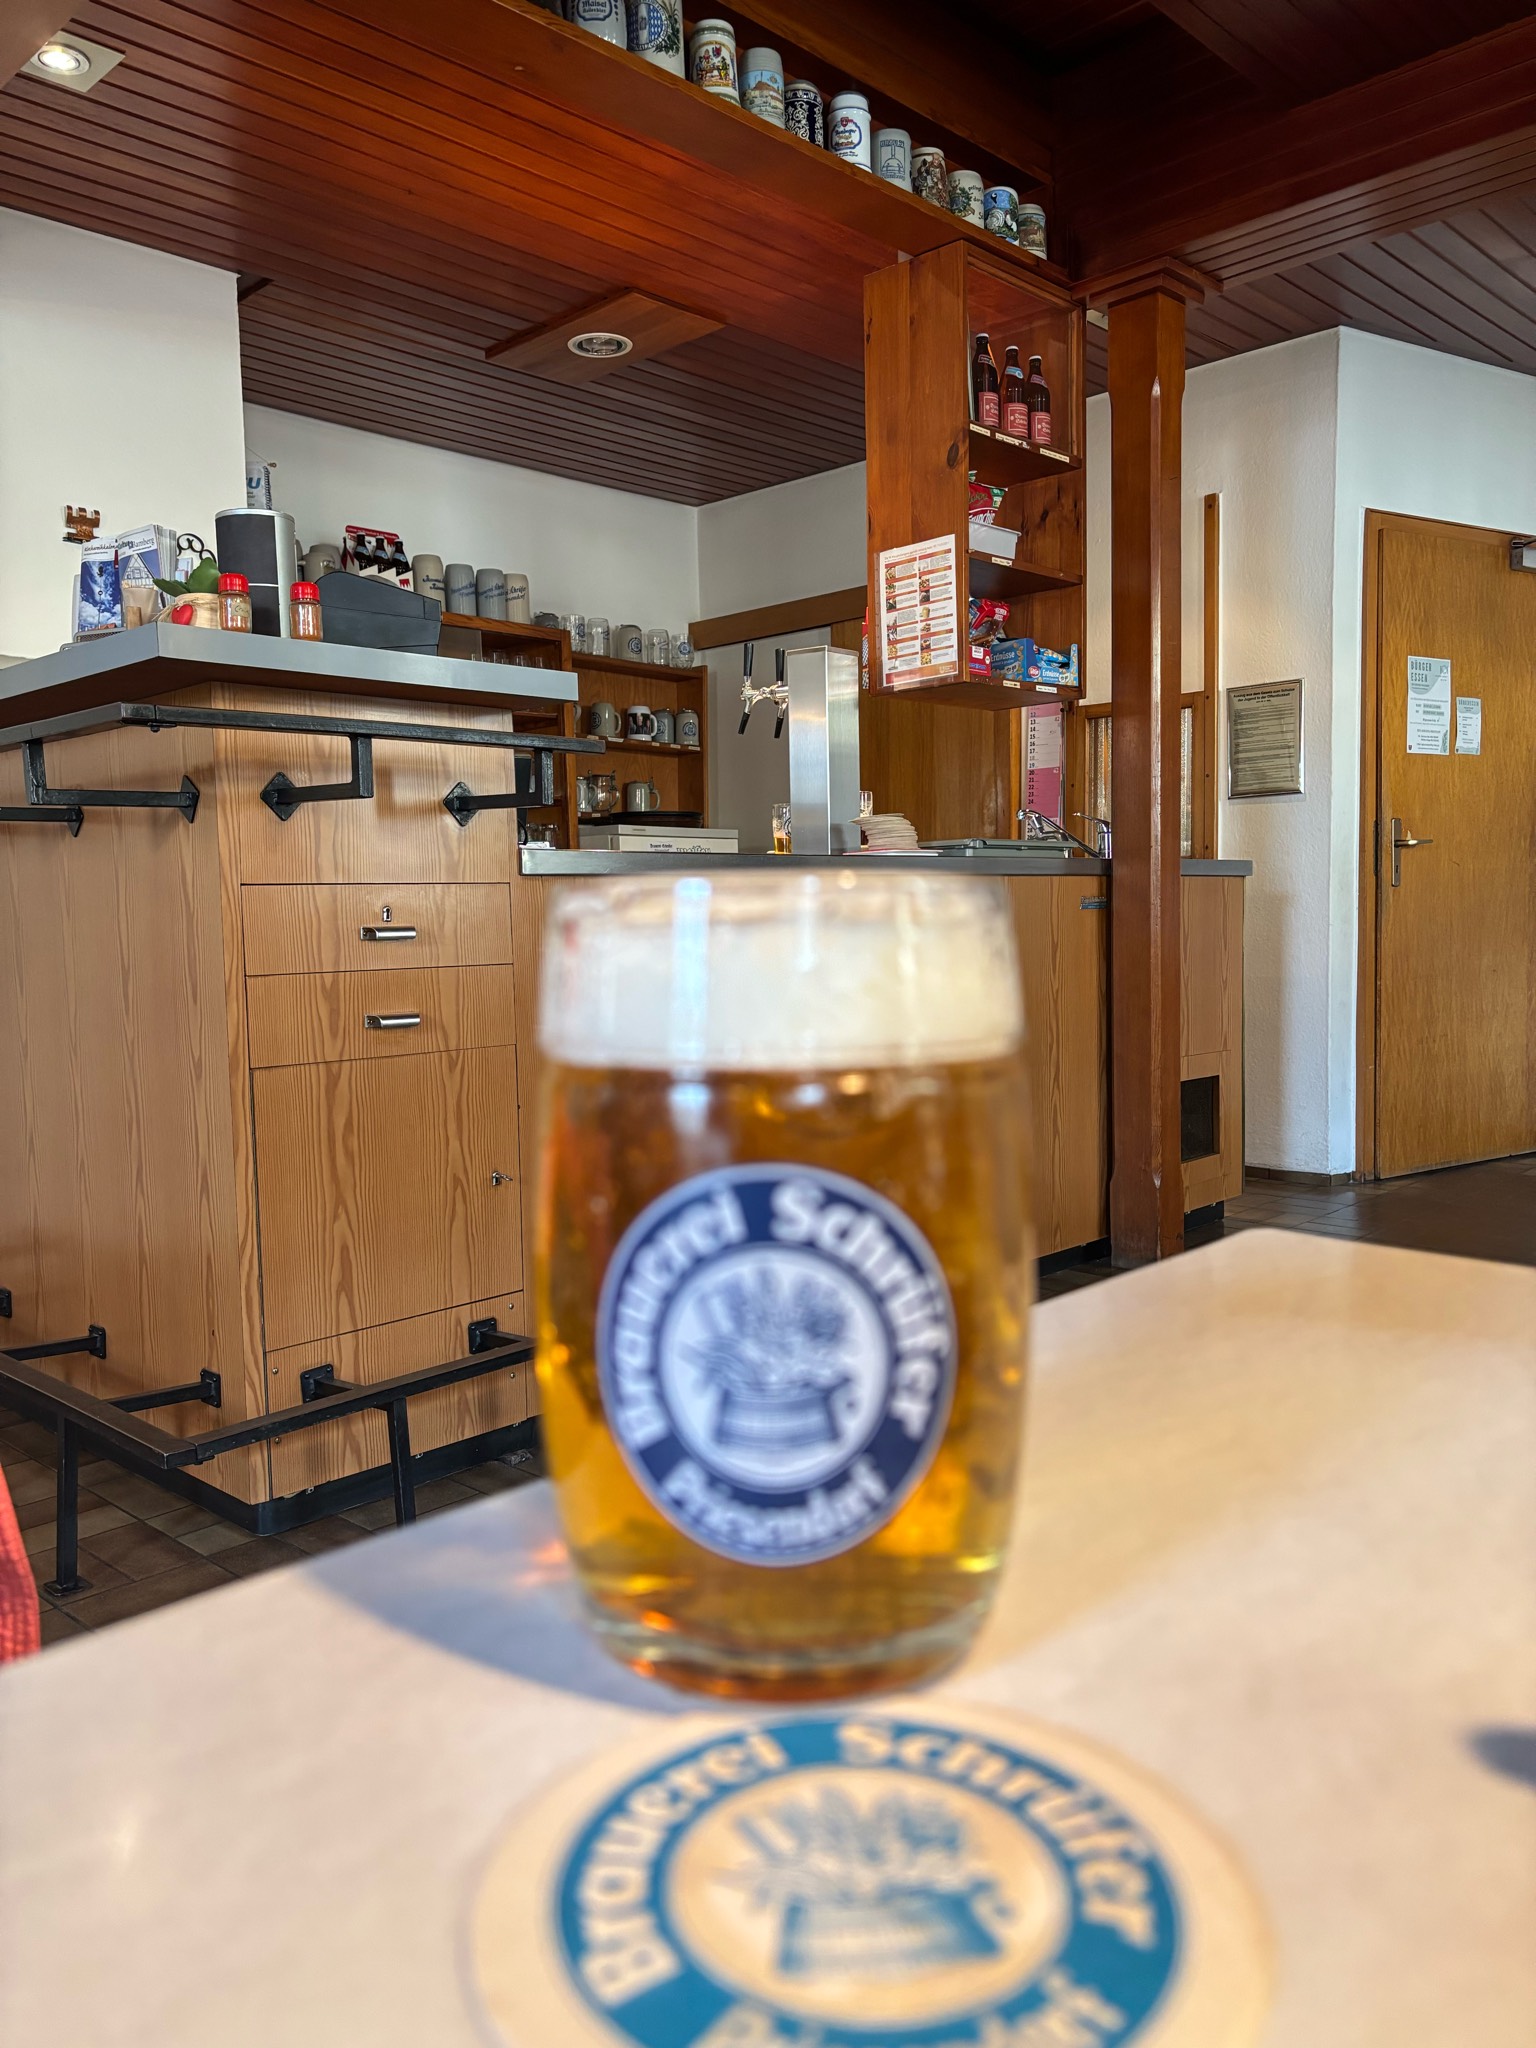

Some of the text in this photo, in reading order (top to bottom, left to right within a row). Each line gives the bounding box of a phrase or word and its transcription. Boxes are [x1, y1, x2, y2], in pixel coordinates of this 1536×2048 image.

[1410, 660, 1432, 672] BÜRGER
[1410, 672, 1428, 683] ESSEN
[579, 1720, 1158, 2007] Brauerei Schrüfer
